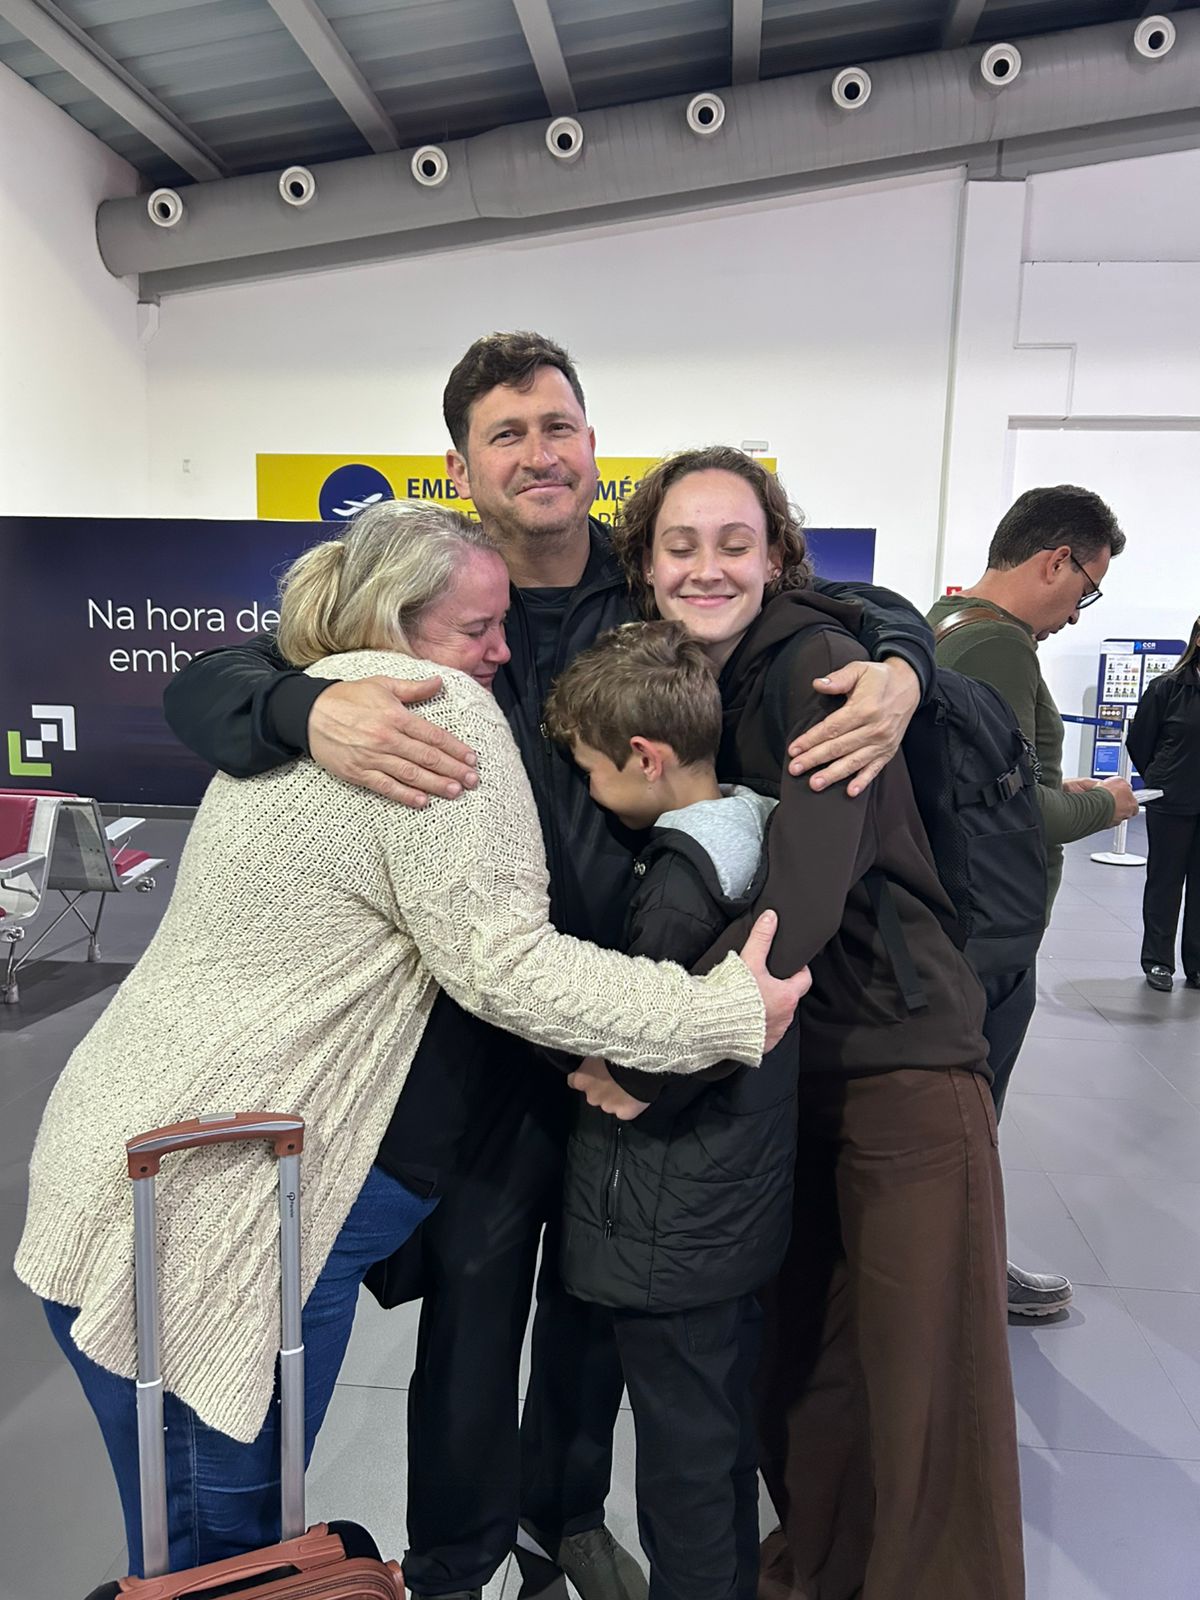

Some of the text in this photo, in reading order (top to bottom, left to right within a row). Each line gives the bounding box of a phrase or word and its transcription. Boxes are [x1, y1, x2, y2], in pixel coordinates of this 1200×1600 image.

[407, 478, 459, 499] EMB
[88, 599, 280, 632] Na hora de
[109, 642, 205, 673] emb
